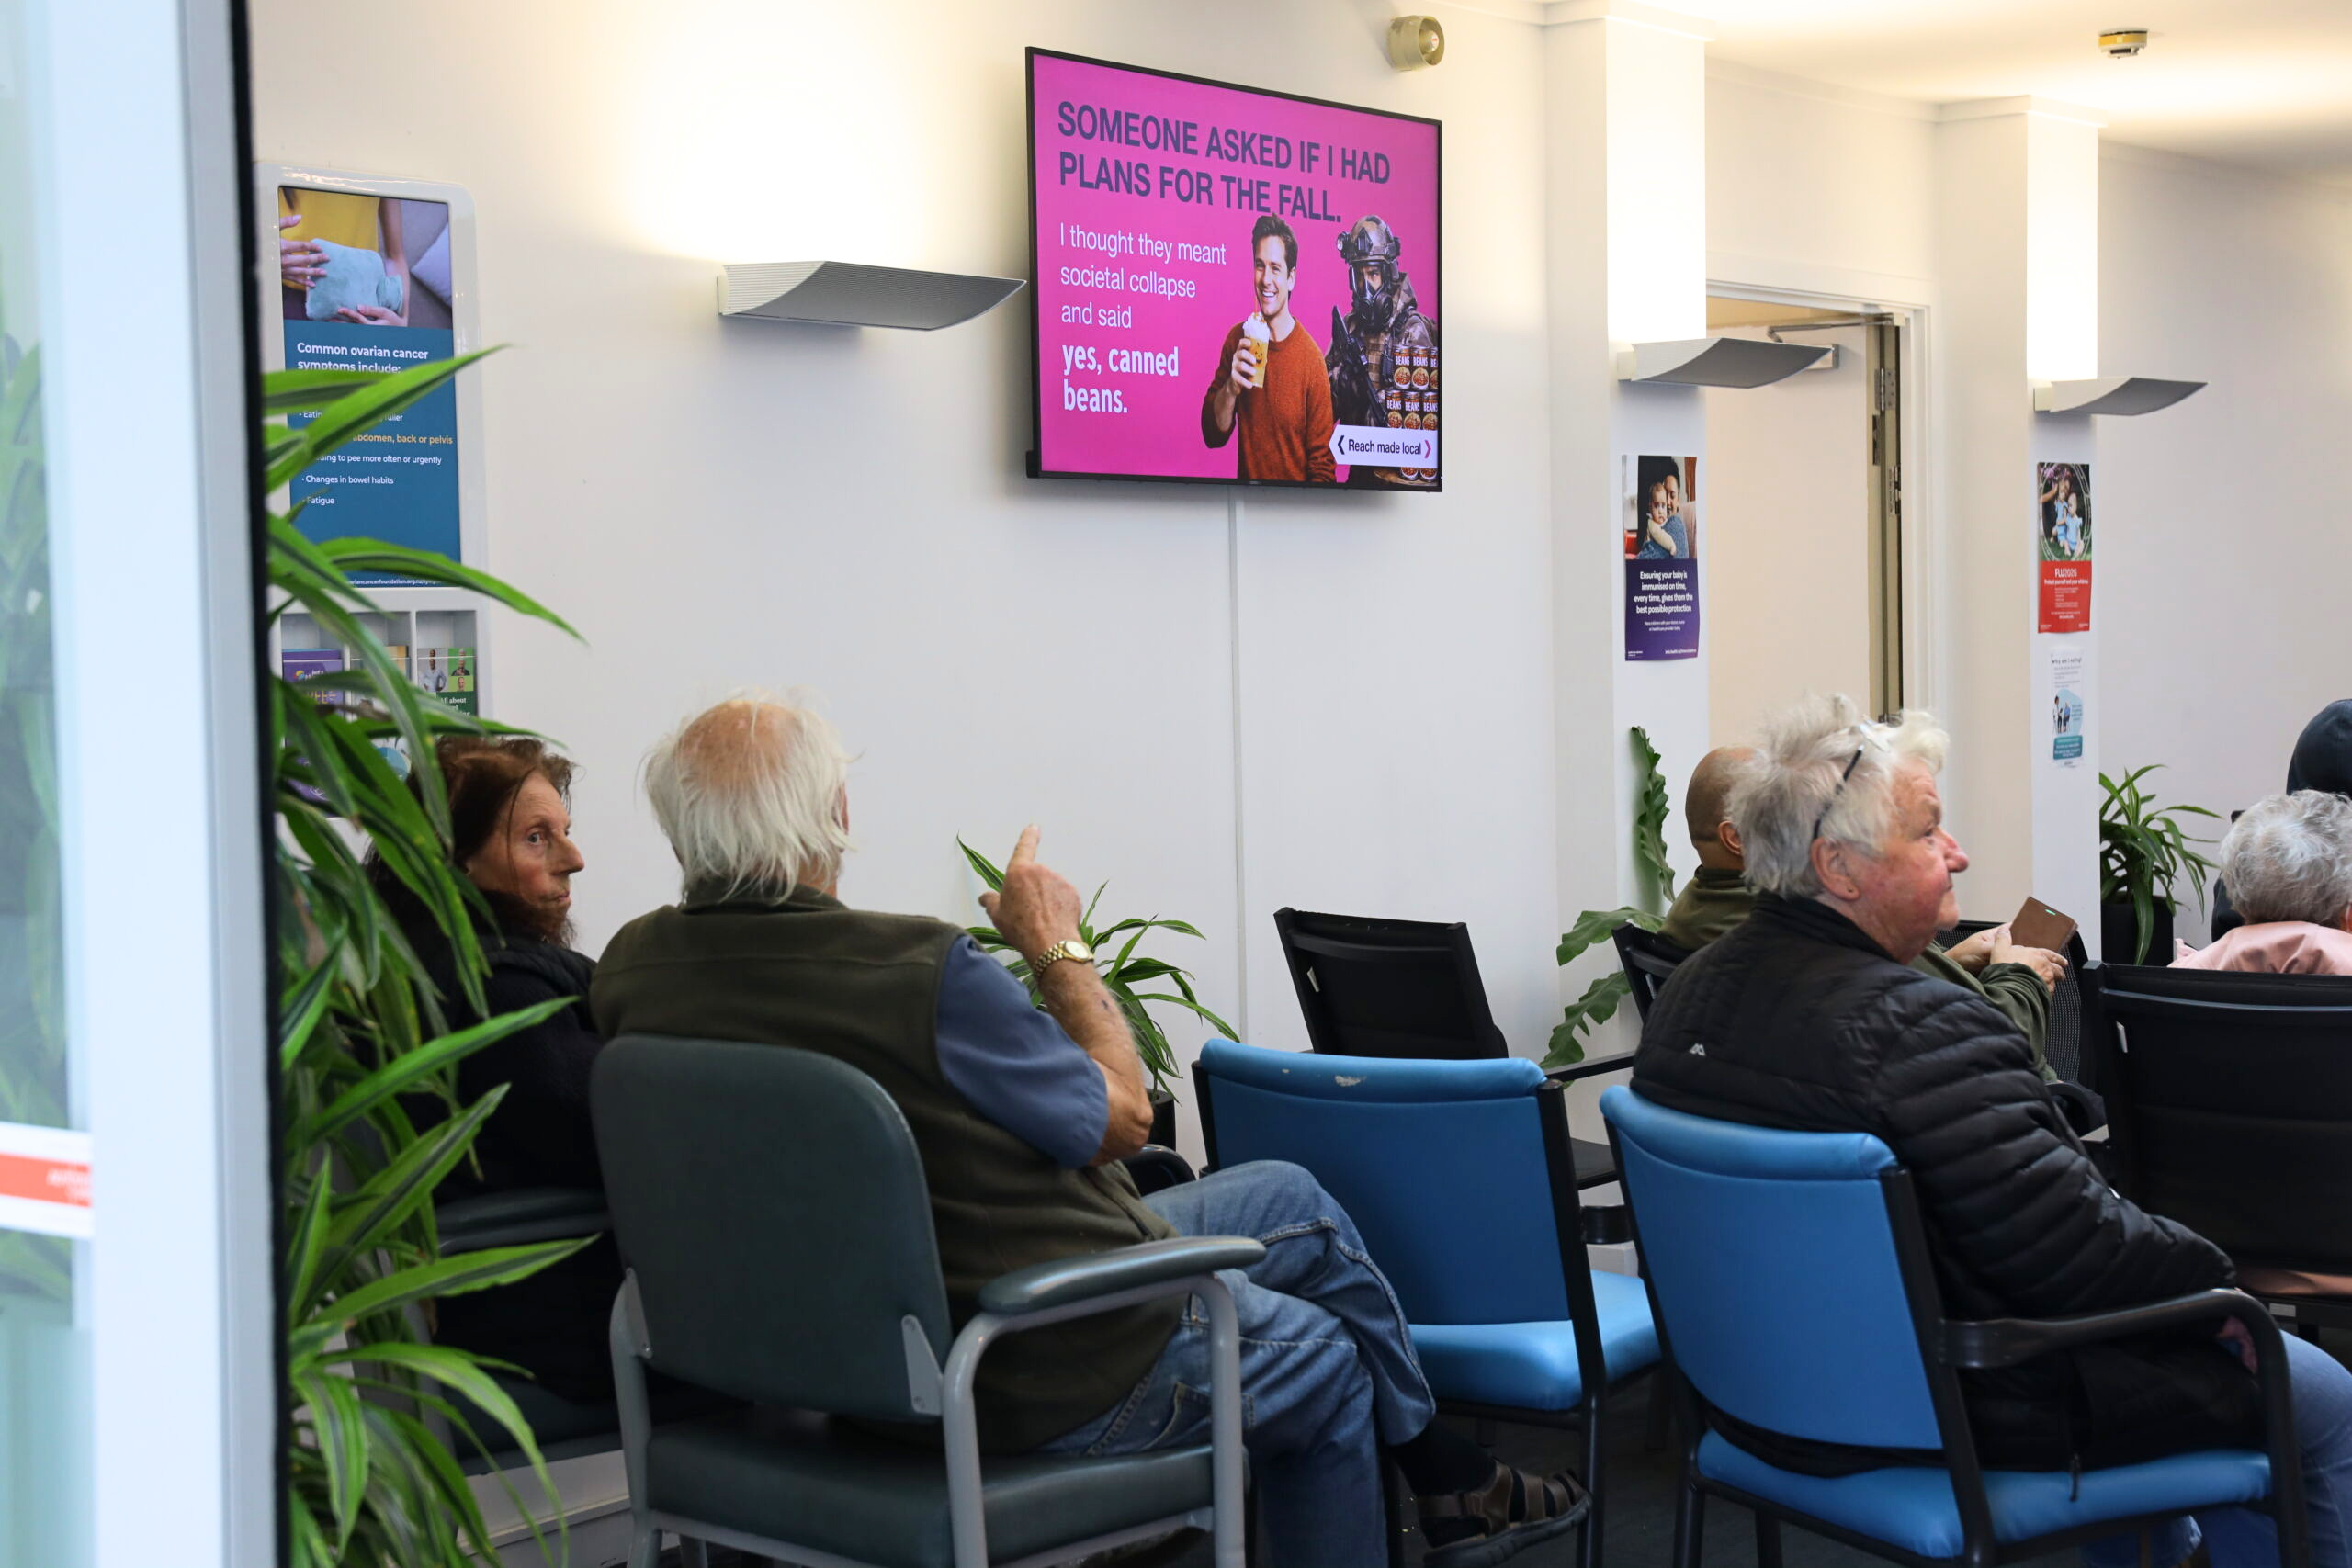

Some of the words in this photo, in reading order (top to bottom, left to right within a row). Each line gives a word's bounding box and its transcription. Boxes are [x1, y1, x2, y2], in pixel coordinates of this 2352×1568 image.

[1057, 101, 1198, 155] SOMEONE
[1205, 126, 1292, 169] ASKED
[1300, 140, 1320, 174] IF
[1328, 145, 1332, 176] I
[1341, 147, 1390, 184] HAD
[1059, 151, 1151, 197] PLANS
[1159, 165, 1213, 205] FOR
[1220, 175, 1271, 213] THE
[1279, 184, 1341, 222] FALL.
[1060, 221, 1064, 246] I
[1069, 224, 1134, 257] thought
[1138, 232, 1173, 264] they
[1178, 243, 1227, 265] meant
[1060, 265, 1125, 290] societal
[1129, 270, 1196, 301] collapse
[1061, 301, 1092, 324] and
[1098, 304, 1132, 328] said
[297, 342, 348, 355] Common
[350, 345, 390, 357] ovarian
[392, 349, 429, 359] cancer
[1062, 344, 1102, 376] yes,
[1108, 346, 1179, 376] canned
[1395, 355, 1410, 366] BEANS
[1413, 356, 1428, 367] BEANS
[1064, 378, 1128, 413] beans.
[1386, 400, 1401, 410] BEANS
[1405, 401, 1419, 412] BEANS
[396, 434, 416, 443] back
[429, 434, 453, 446] pelvis
[1348, 439, 1375, 453] Reach
[1377, 442, 1399, 454] made
[1402, 442, 1421, 455] local
[347, 456, 361, 464] pee
[383, 455, 401, 463] often
[412, 456, 442, 466] urgently
[305, 475, 338, 485] Changes
[340, 475, 346, 483] in
[348, 476, 370, 484] bowel
[371, 476, 394, 484] habits
[307, 496, 334, 505] Fatigue
[1640, 570, 1661, 581] Ensuring
[1662, 572, 1673, 581] your
[1673, 570, 1683, 580] baby
[1641, 581, 1668, 591] immunised
[1634, 595, 1648, 604] every
[1636, 605, 1647, 614] best
[1648, 604, 1668, 615] possible
[1668, 604, 1692, 615] protection
